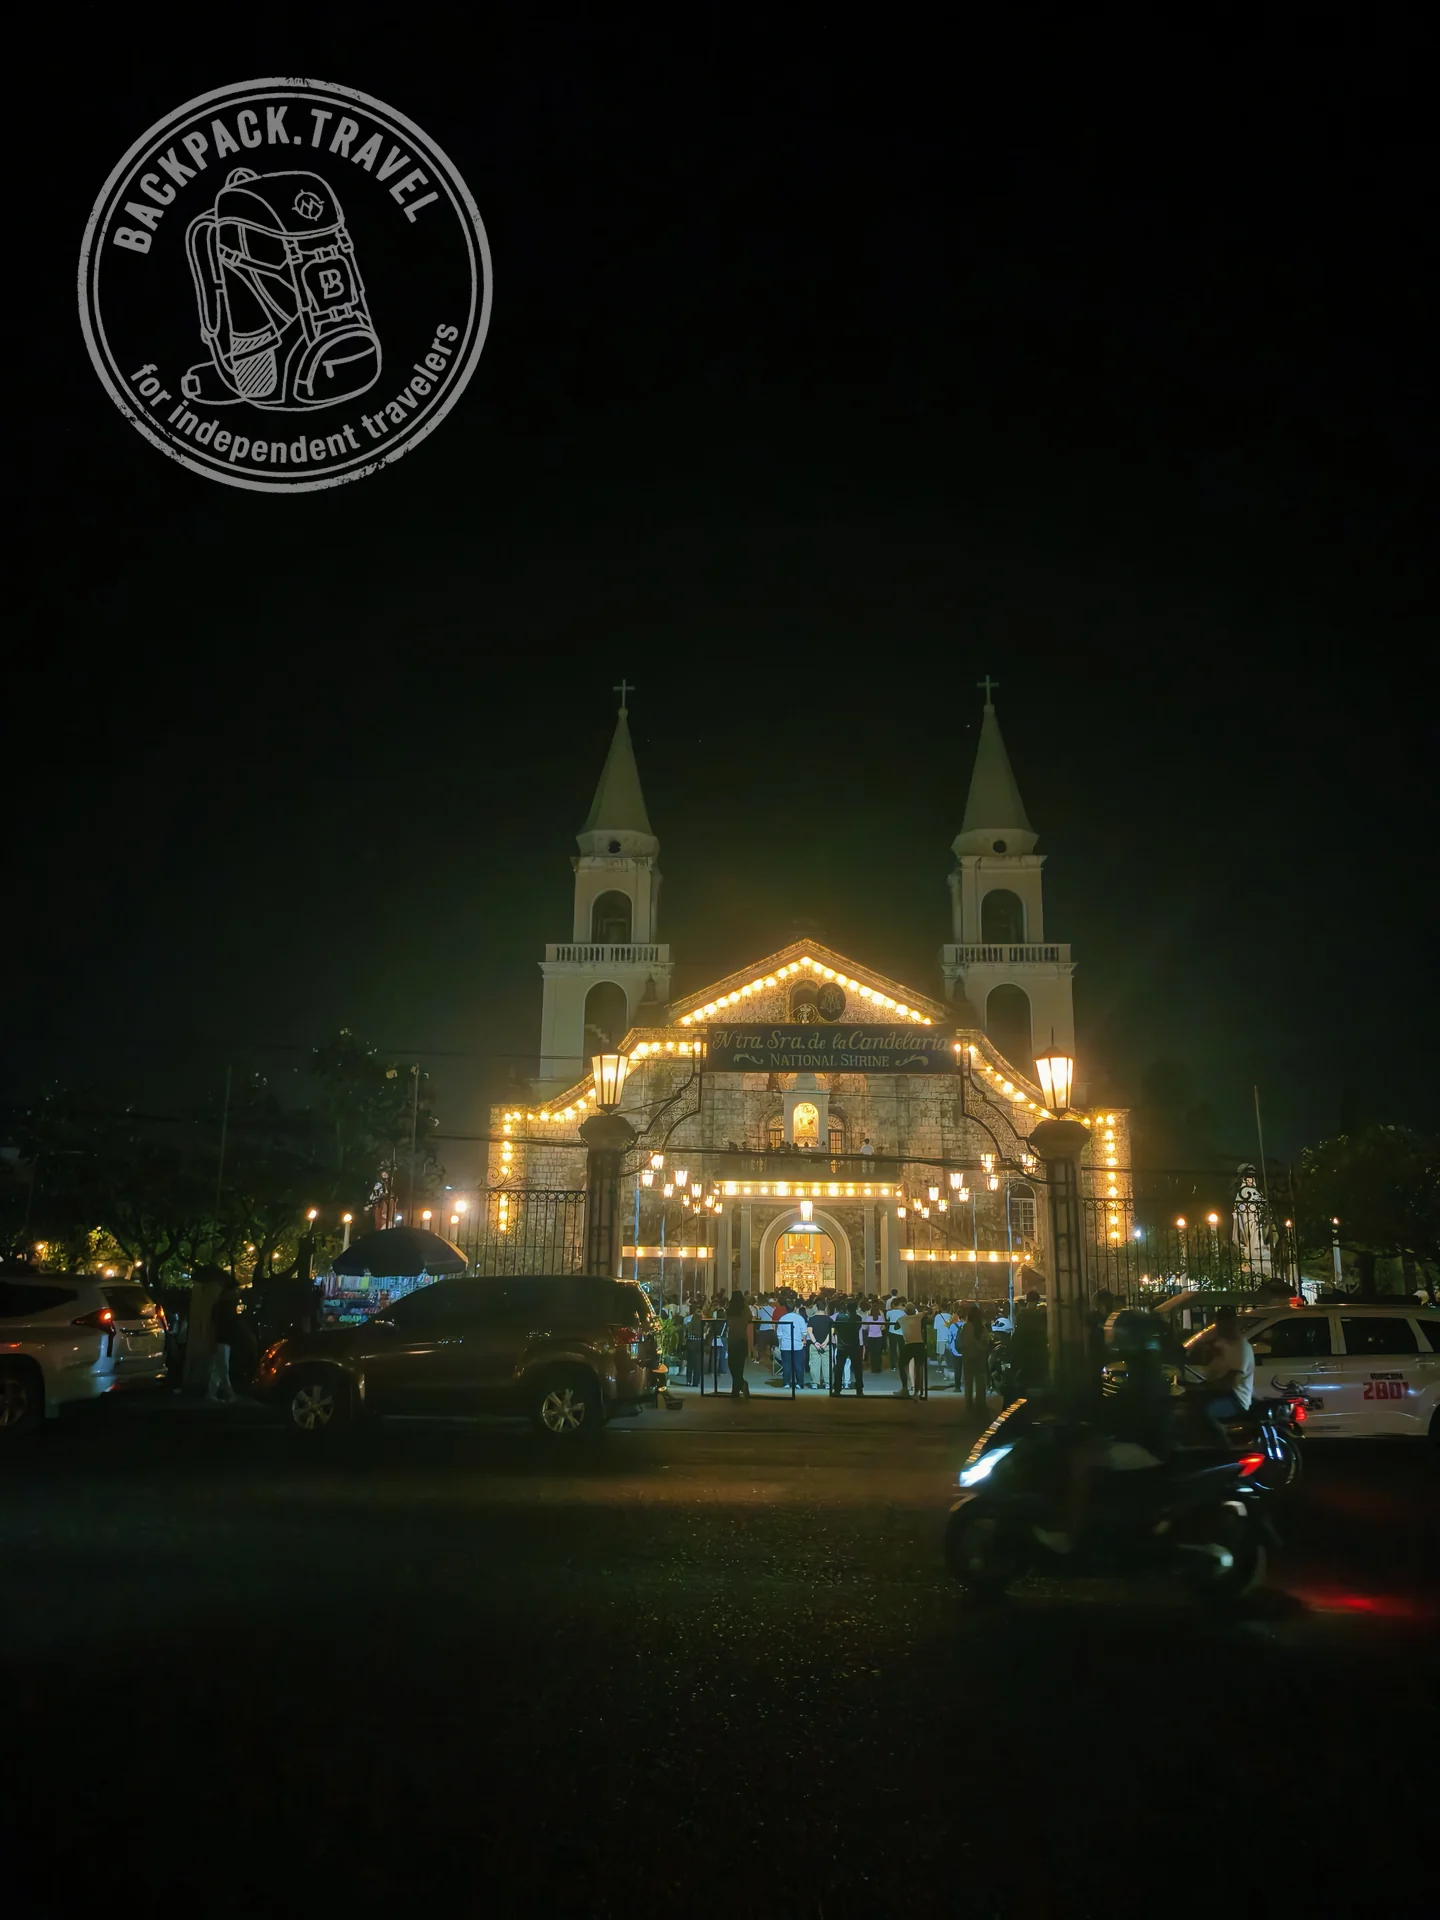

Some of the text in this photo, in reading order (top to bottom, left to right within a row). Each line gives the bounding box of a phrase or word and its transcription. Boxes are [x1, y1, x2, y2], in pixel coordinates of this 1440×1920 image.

[767, 1030, 805, 1049] Sra.
[809, 1032, 826, 1049] de
[833, 1032, 846, 1049] la
[848, 1030, 949, 1050] Candelaria
[770, 1053, 890, 1067] NATIONAL SHRINE
